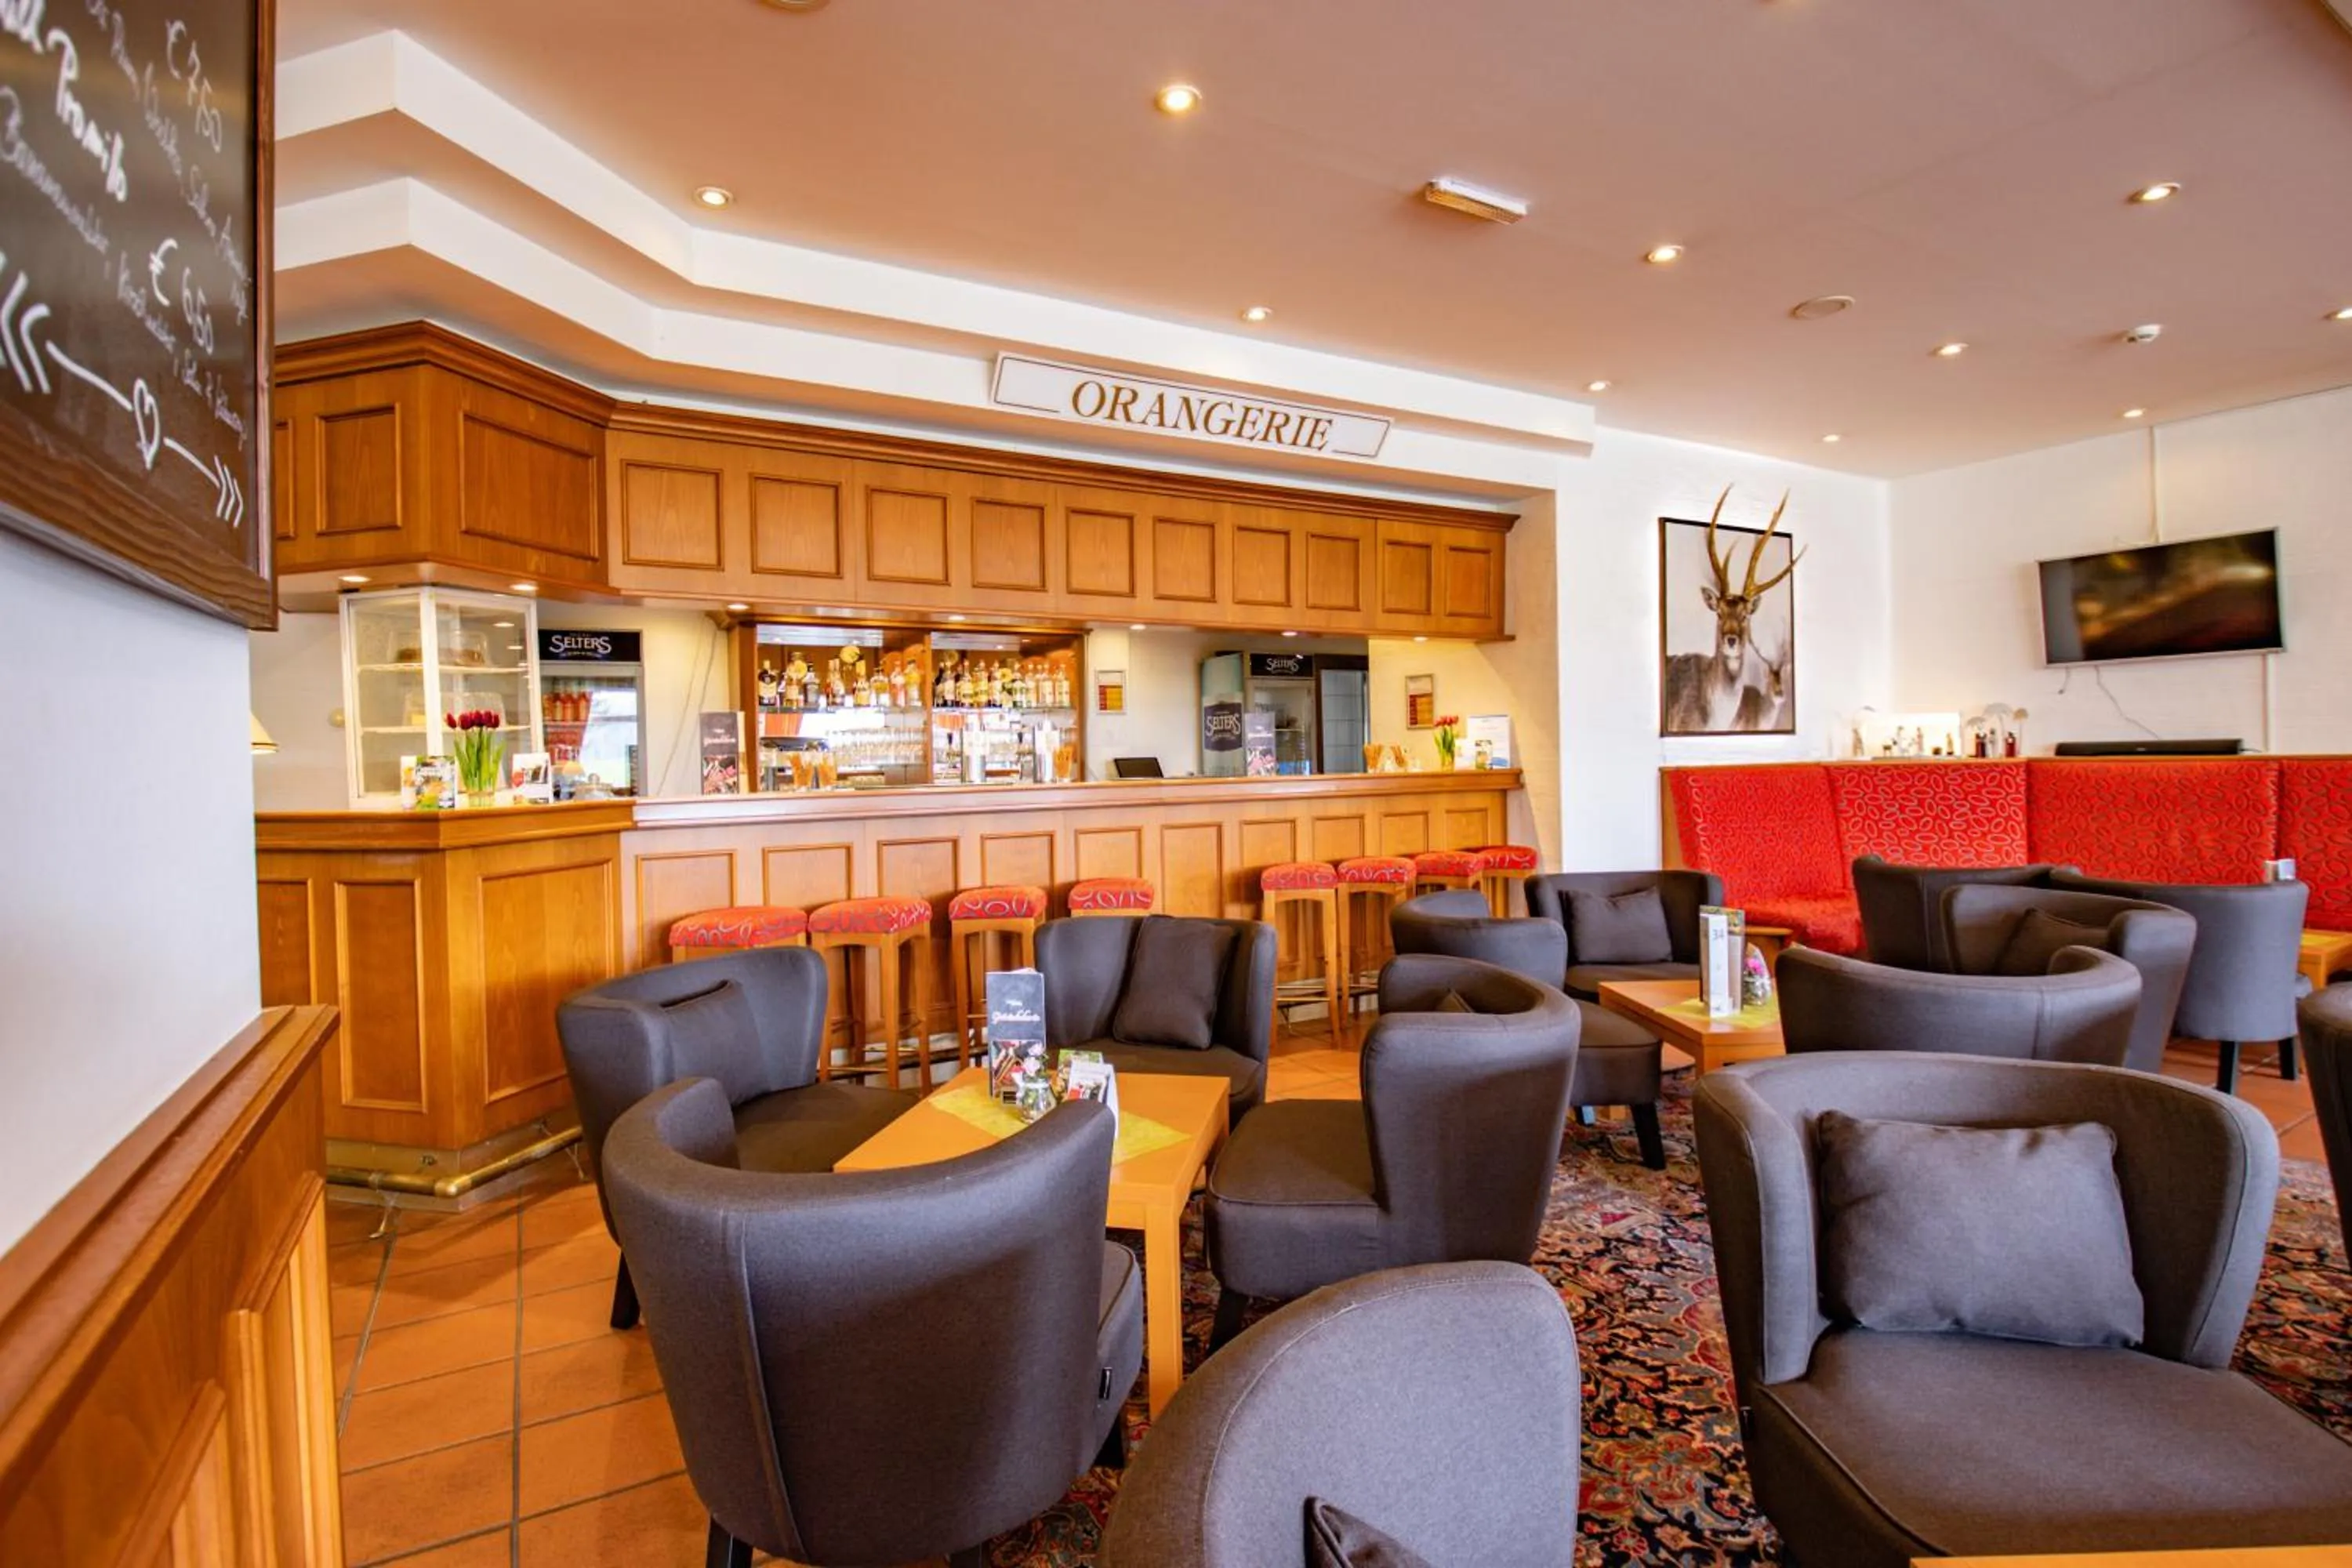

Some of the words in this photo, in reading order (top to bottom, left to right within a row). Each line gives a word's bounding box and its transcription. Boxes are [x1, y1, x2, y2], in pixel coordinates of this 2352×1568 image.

[165, 18, 187, 80] €
[149, 238, 179, 307] €
[1071, 380, 1334, 452] ORANGERIE
[549, 634, 612, 654] SELTERS
[1206, 713, 1241, 737] SELTERS
